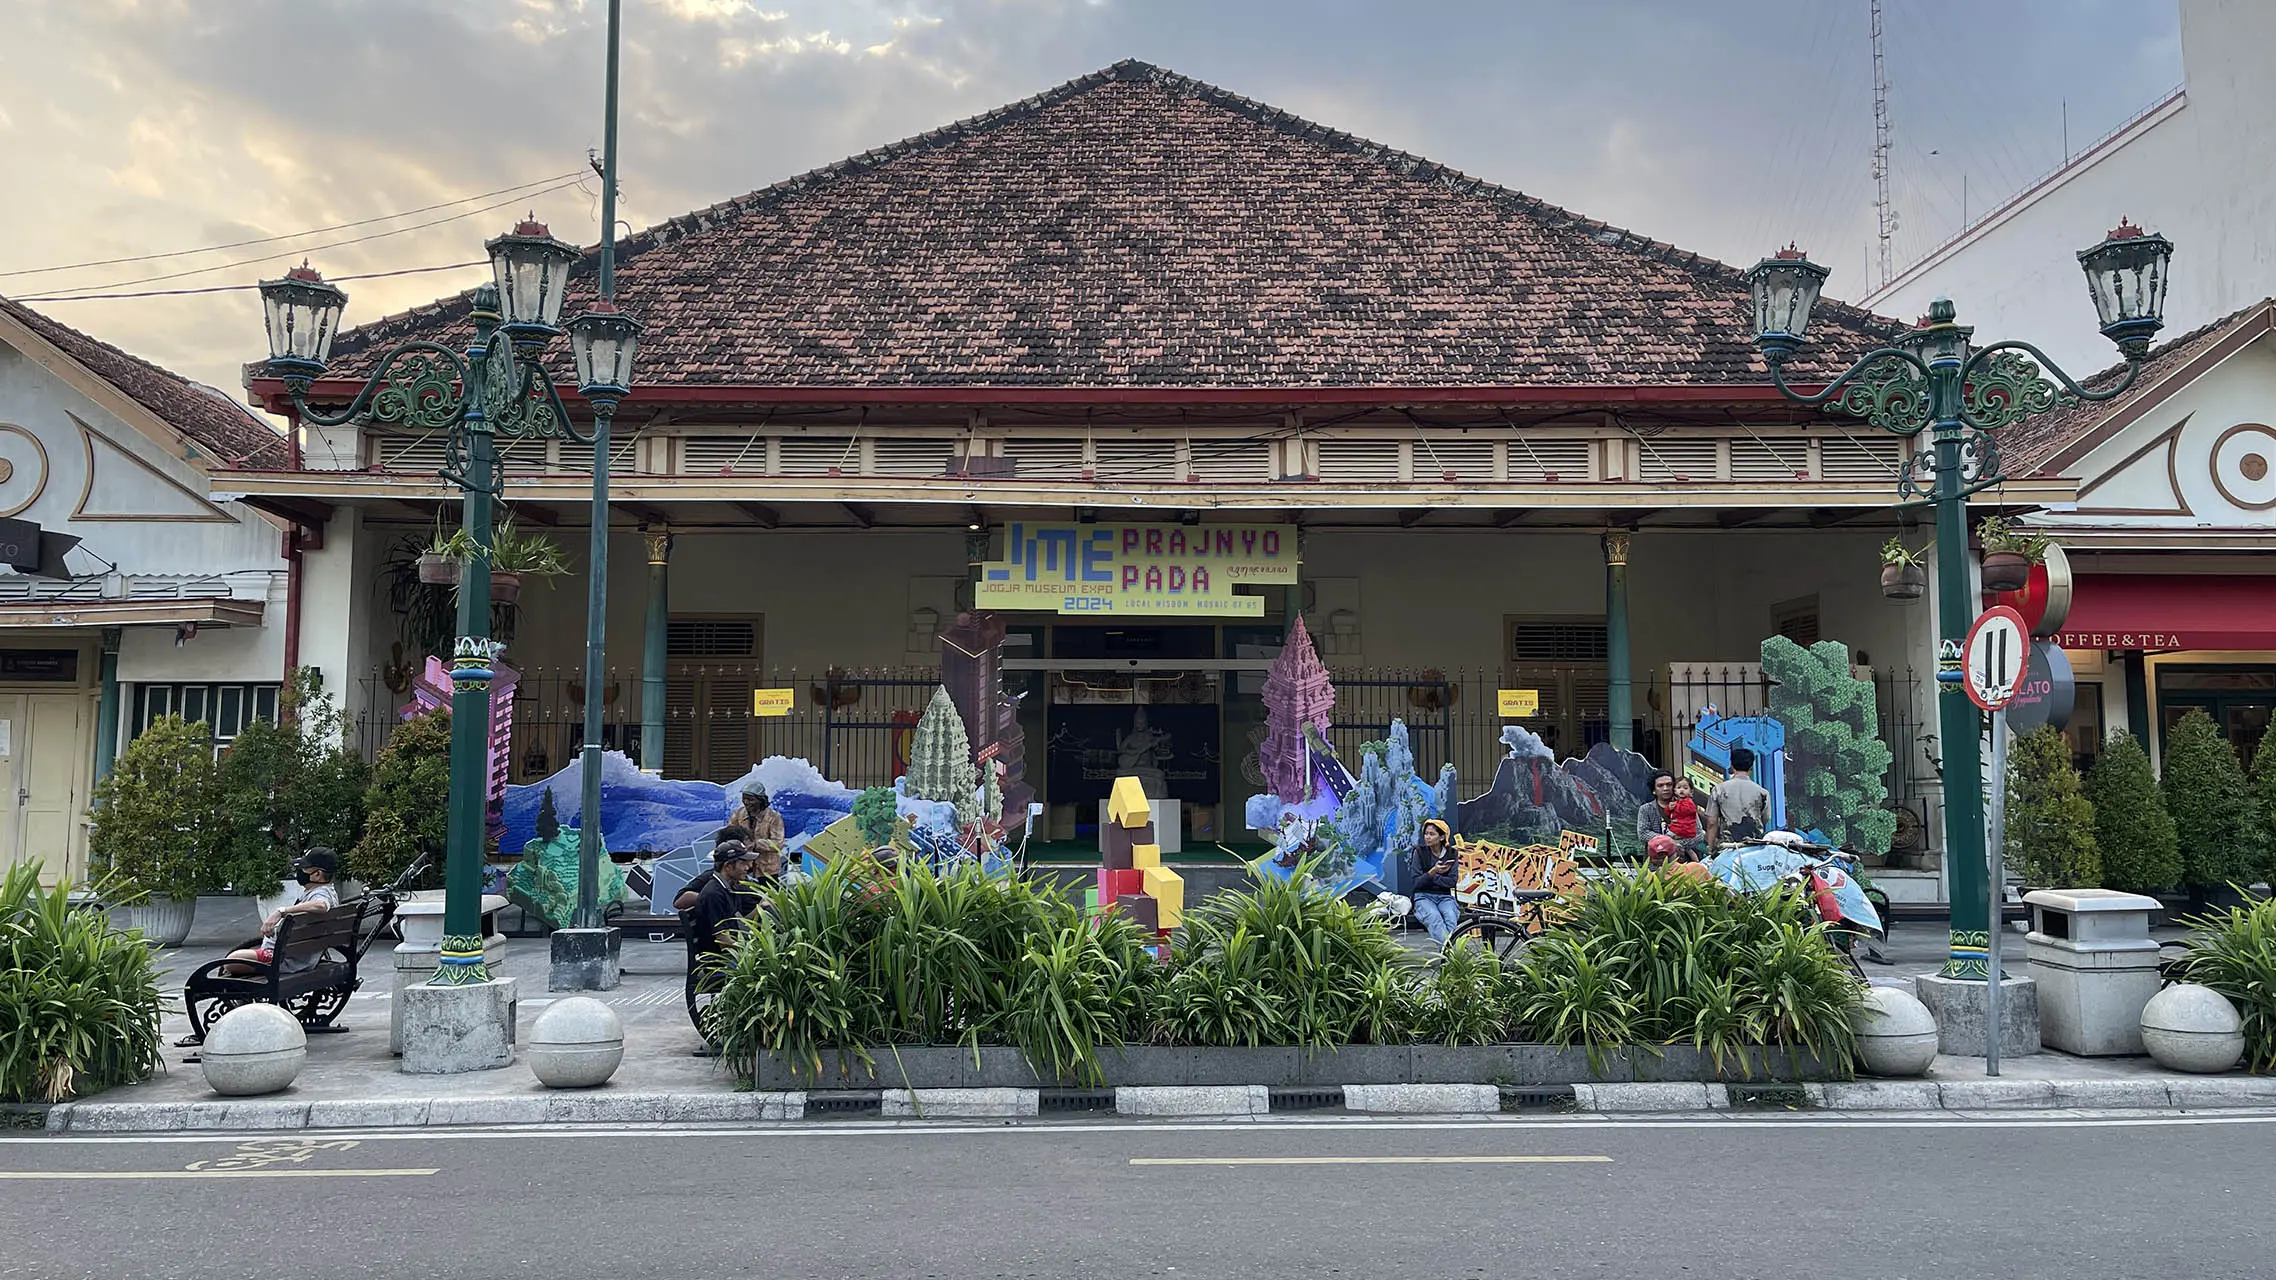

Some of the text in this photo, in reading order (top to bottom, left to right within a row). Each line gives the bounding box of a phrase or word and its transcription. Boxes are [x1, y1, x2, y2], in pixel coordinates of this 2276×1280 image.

[1122, 528, 1281, 557] PRAJNYO
[1122, 565, 1211, 594] PADA
[981, 583, 1114, 595] JOGJA MUSEUM EXPO
[1064, 596, 1113, 610] 2024
[1125, 599, 1152, 608] LOCAL
[1155, 599, 1189, 609] WISDOM
[1197, 600, 1228, 609] MOSAIC
[1232, 600, 1242, 609] OF
[2035, 632, 2181, 647] OFFEE&TEA
